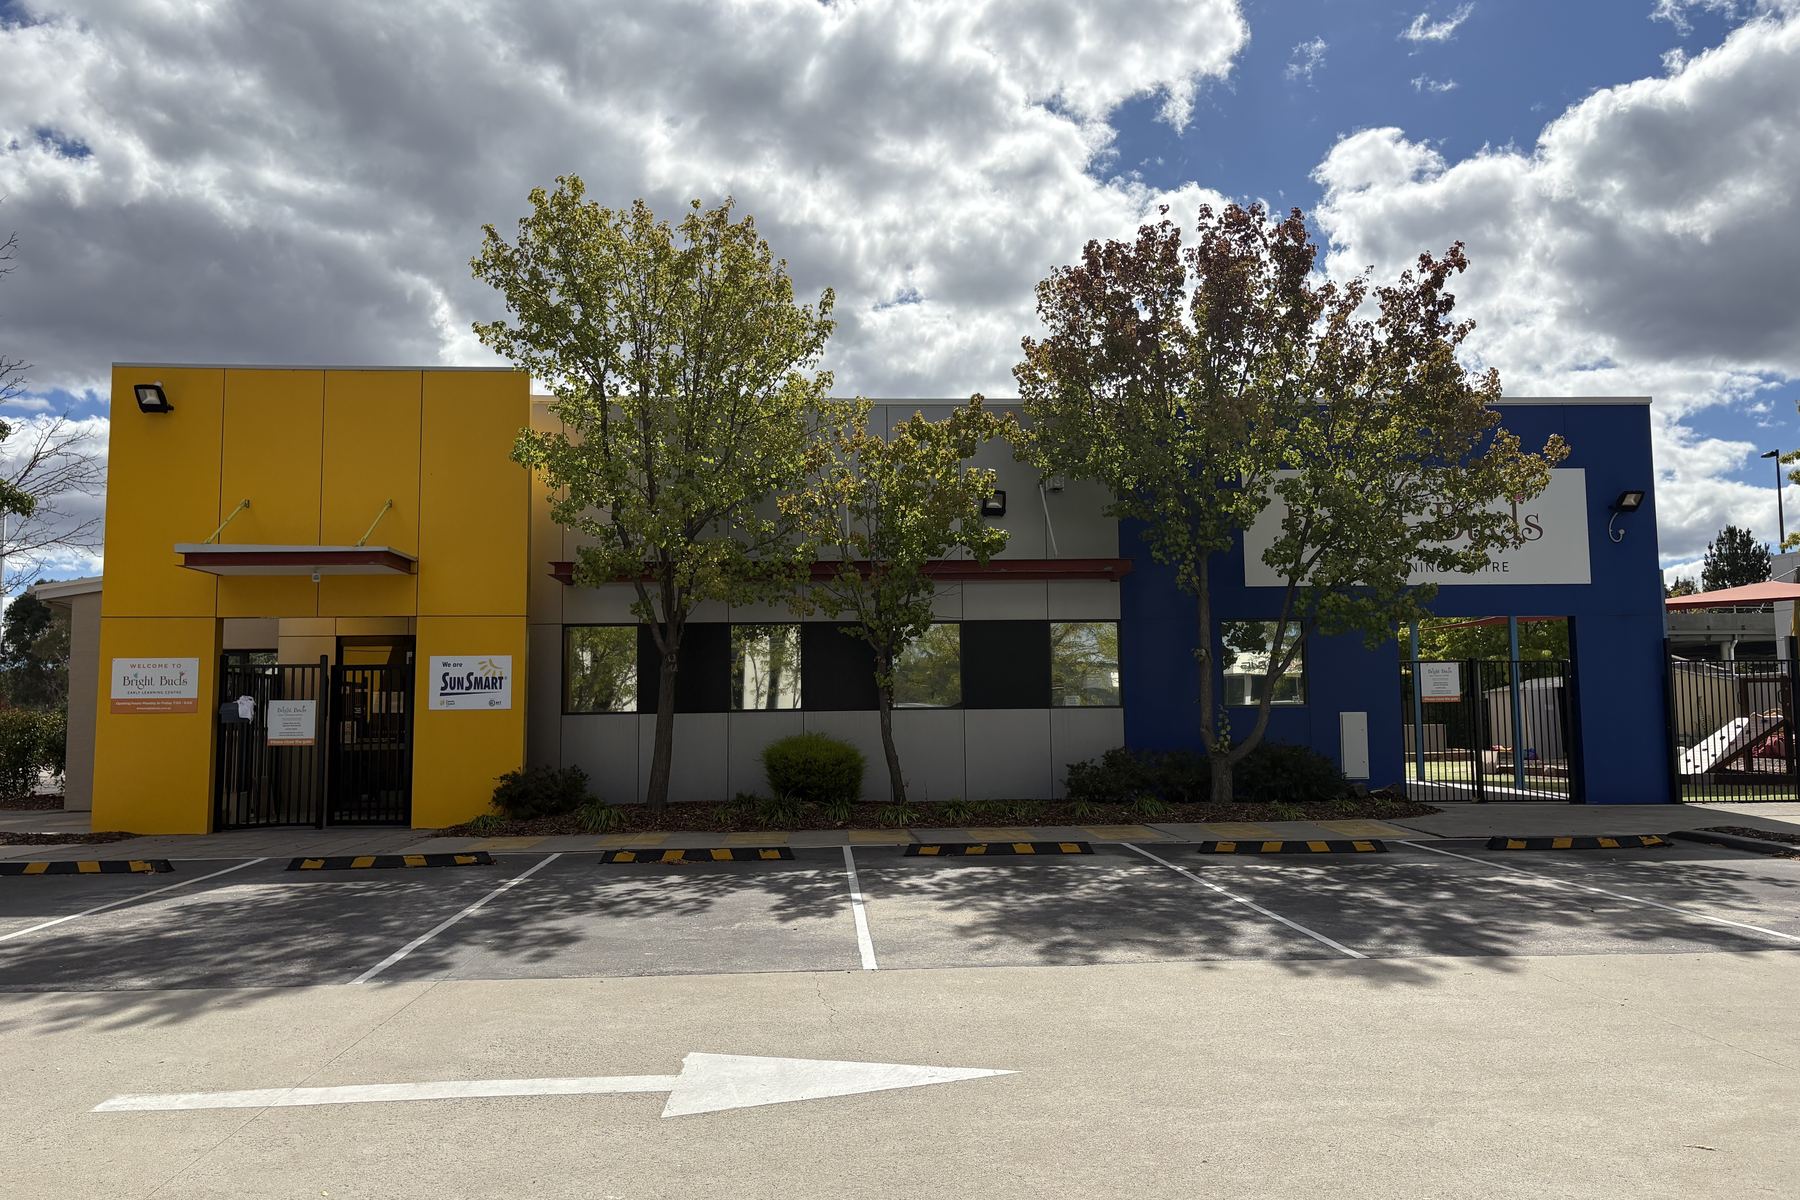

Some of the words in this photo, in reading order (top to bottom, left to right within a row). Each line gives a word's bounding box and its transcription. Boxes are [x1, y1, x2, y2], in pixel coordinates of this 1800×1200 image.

[1432, 498, 1544, 541] Bds
[123, 673, 154, 690] Bright
[160, 671, 188, 686] Buds
